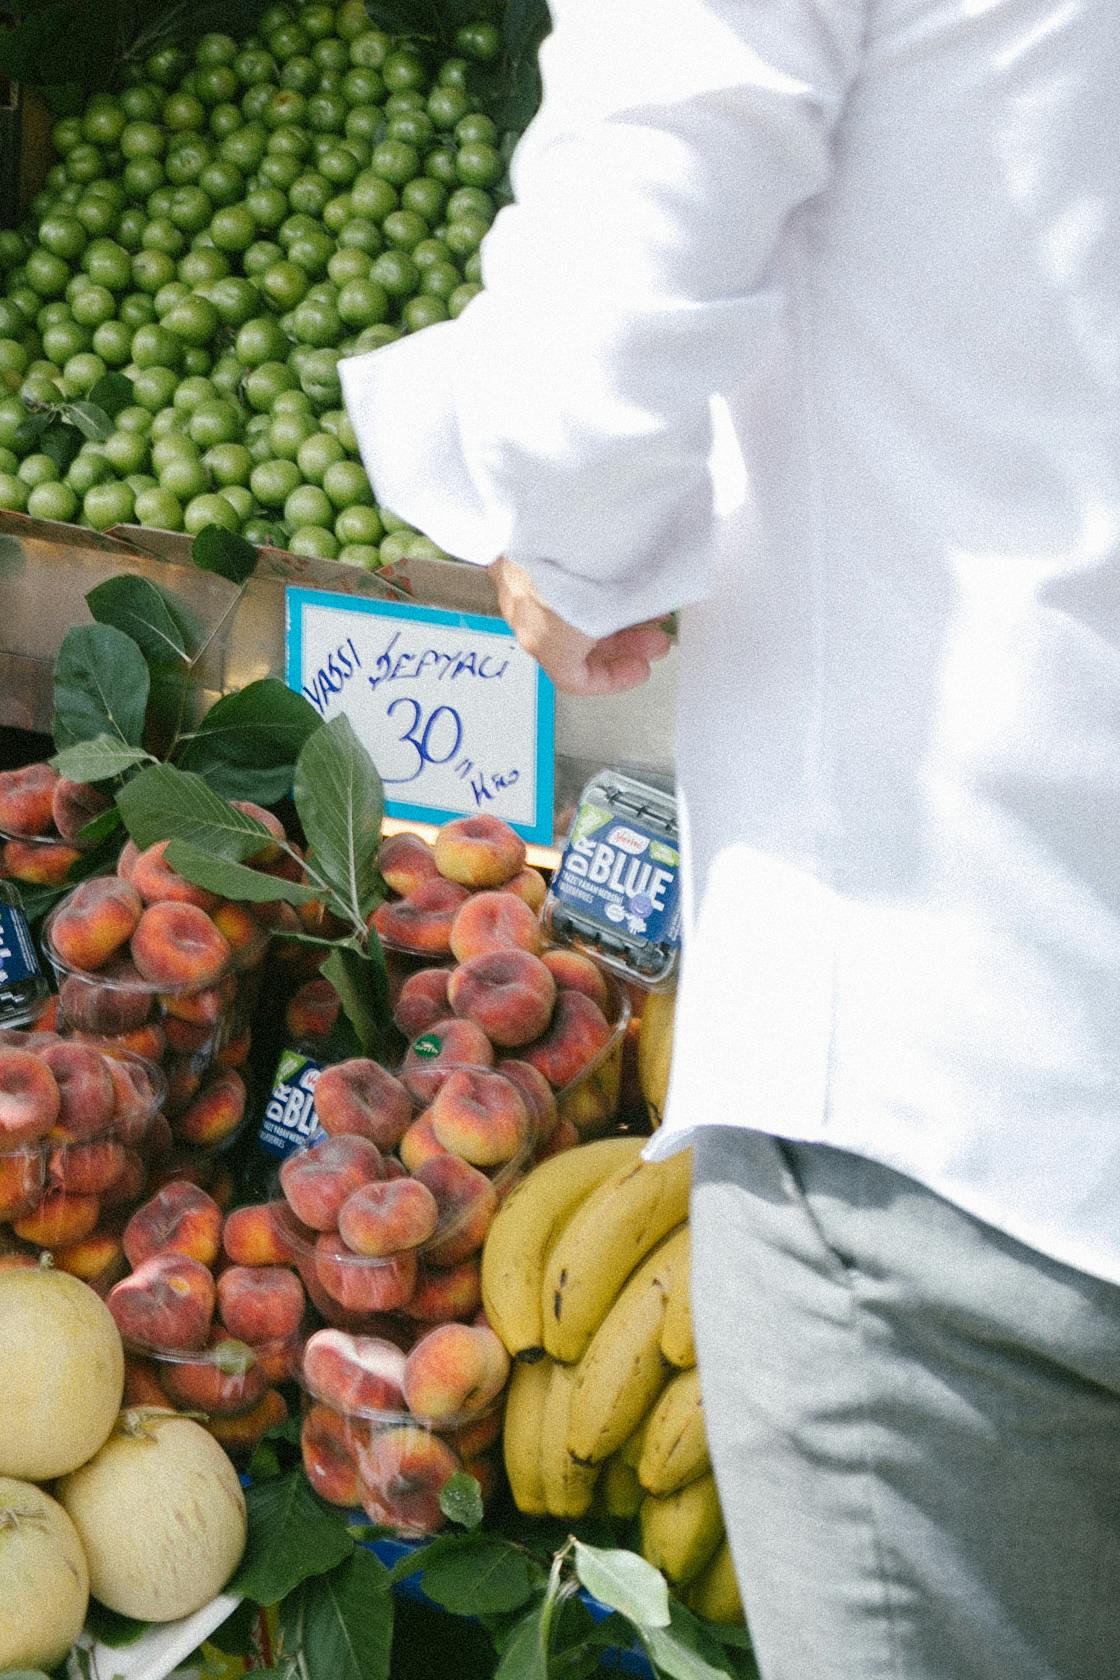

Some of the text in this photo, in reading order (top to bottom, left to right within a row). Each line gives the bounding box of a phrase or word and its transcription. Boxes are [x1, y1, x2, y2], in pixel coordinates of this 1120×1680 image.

[303, 637, 362, 714] YASSI
[380, 697, 464, 784] 30
[564, 835, 598, 878] DR
[586, 841, 675, 913] BLUE
[265, 1081, 292, 1123] DR
